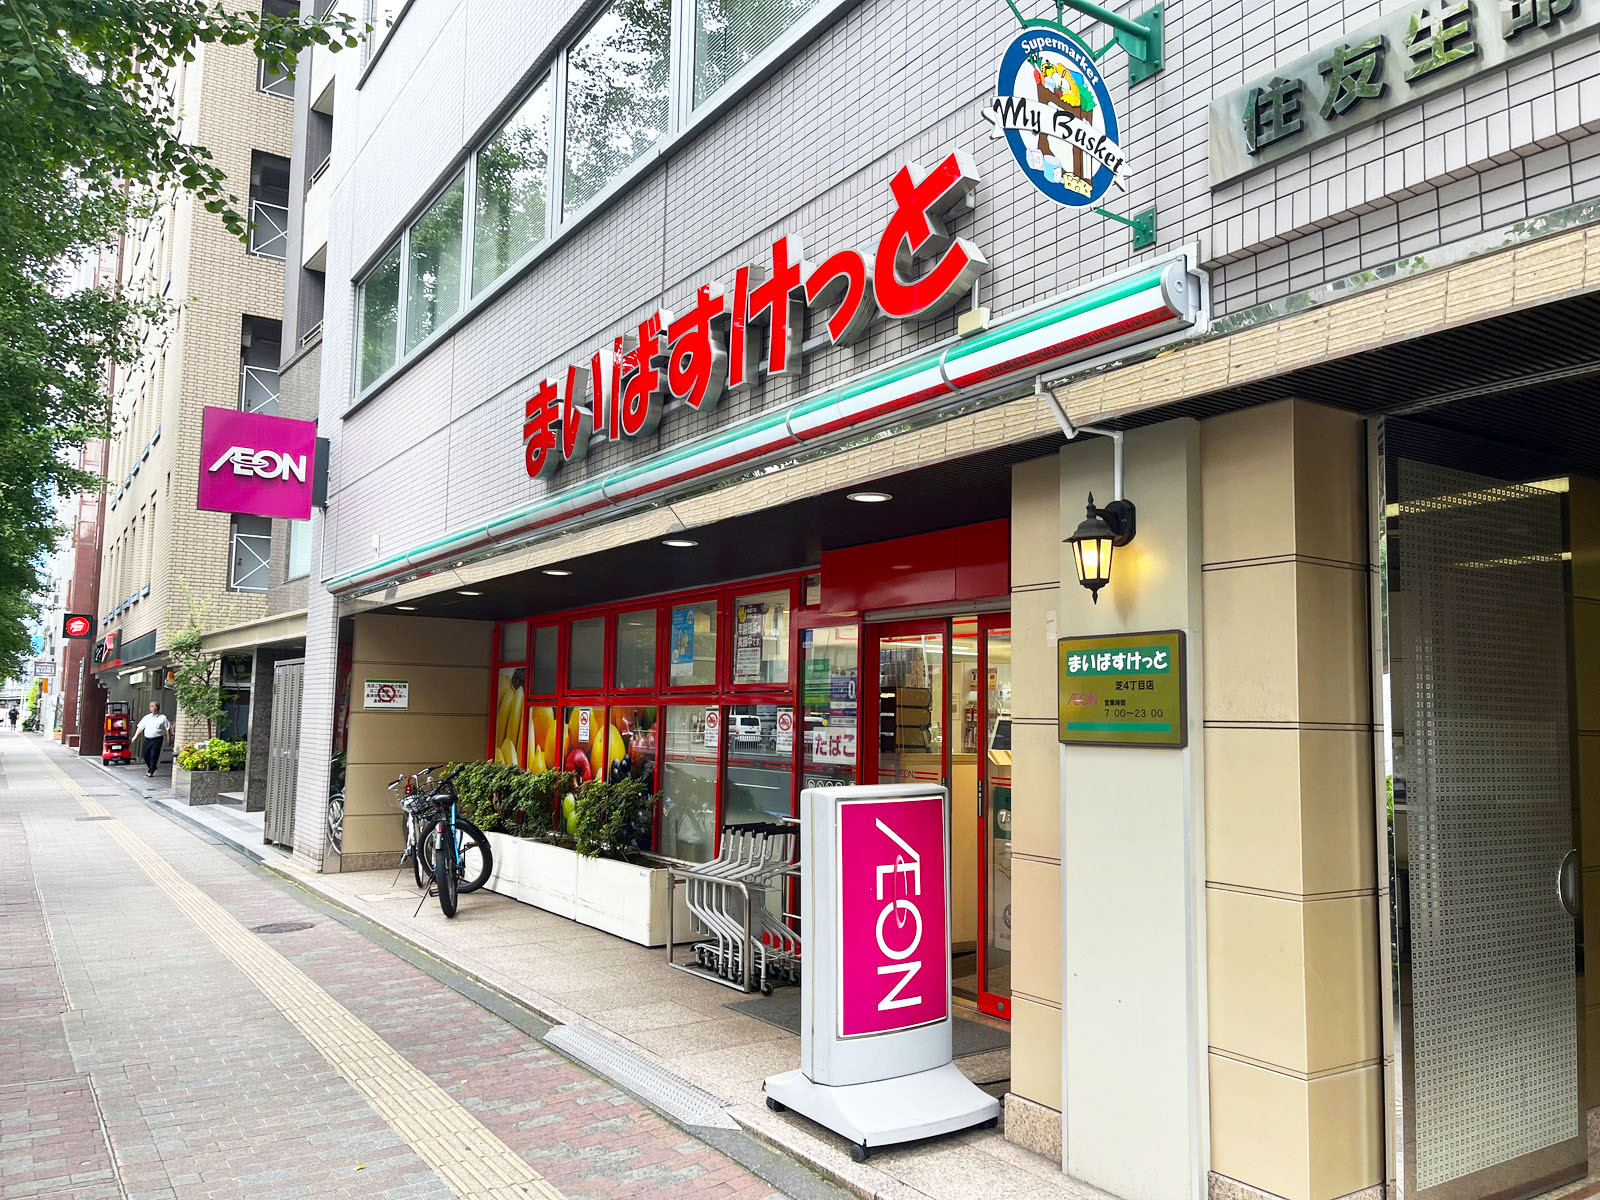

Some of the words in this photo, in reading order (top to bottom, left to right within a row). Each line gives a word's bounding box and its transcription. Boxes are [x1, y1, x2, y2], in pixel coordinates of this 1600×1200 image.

[1021, 36, 1099, 86] Supermarket
[993, 96, 1041, 135] My
[1053, 109, 1125, 174] Basket
[523, 150, 984, 479] まいばすけっと
[208, 446, 307, 483] AEON
[1068, 652, 1167, 673] まいばすけっと
[1104, 699, 1126, 707] 営業時間
[1115, 680, 1155, 691] 芝4丁目店
[815, 733, 855, 758] たばこ
[876, 817, 923, 1012] AEON
